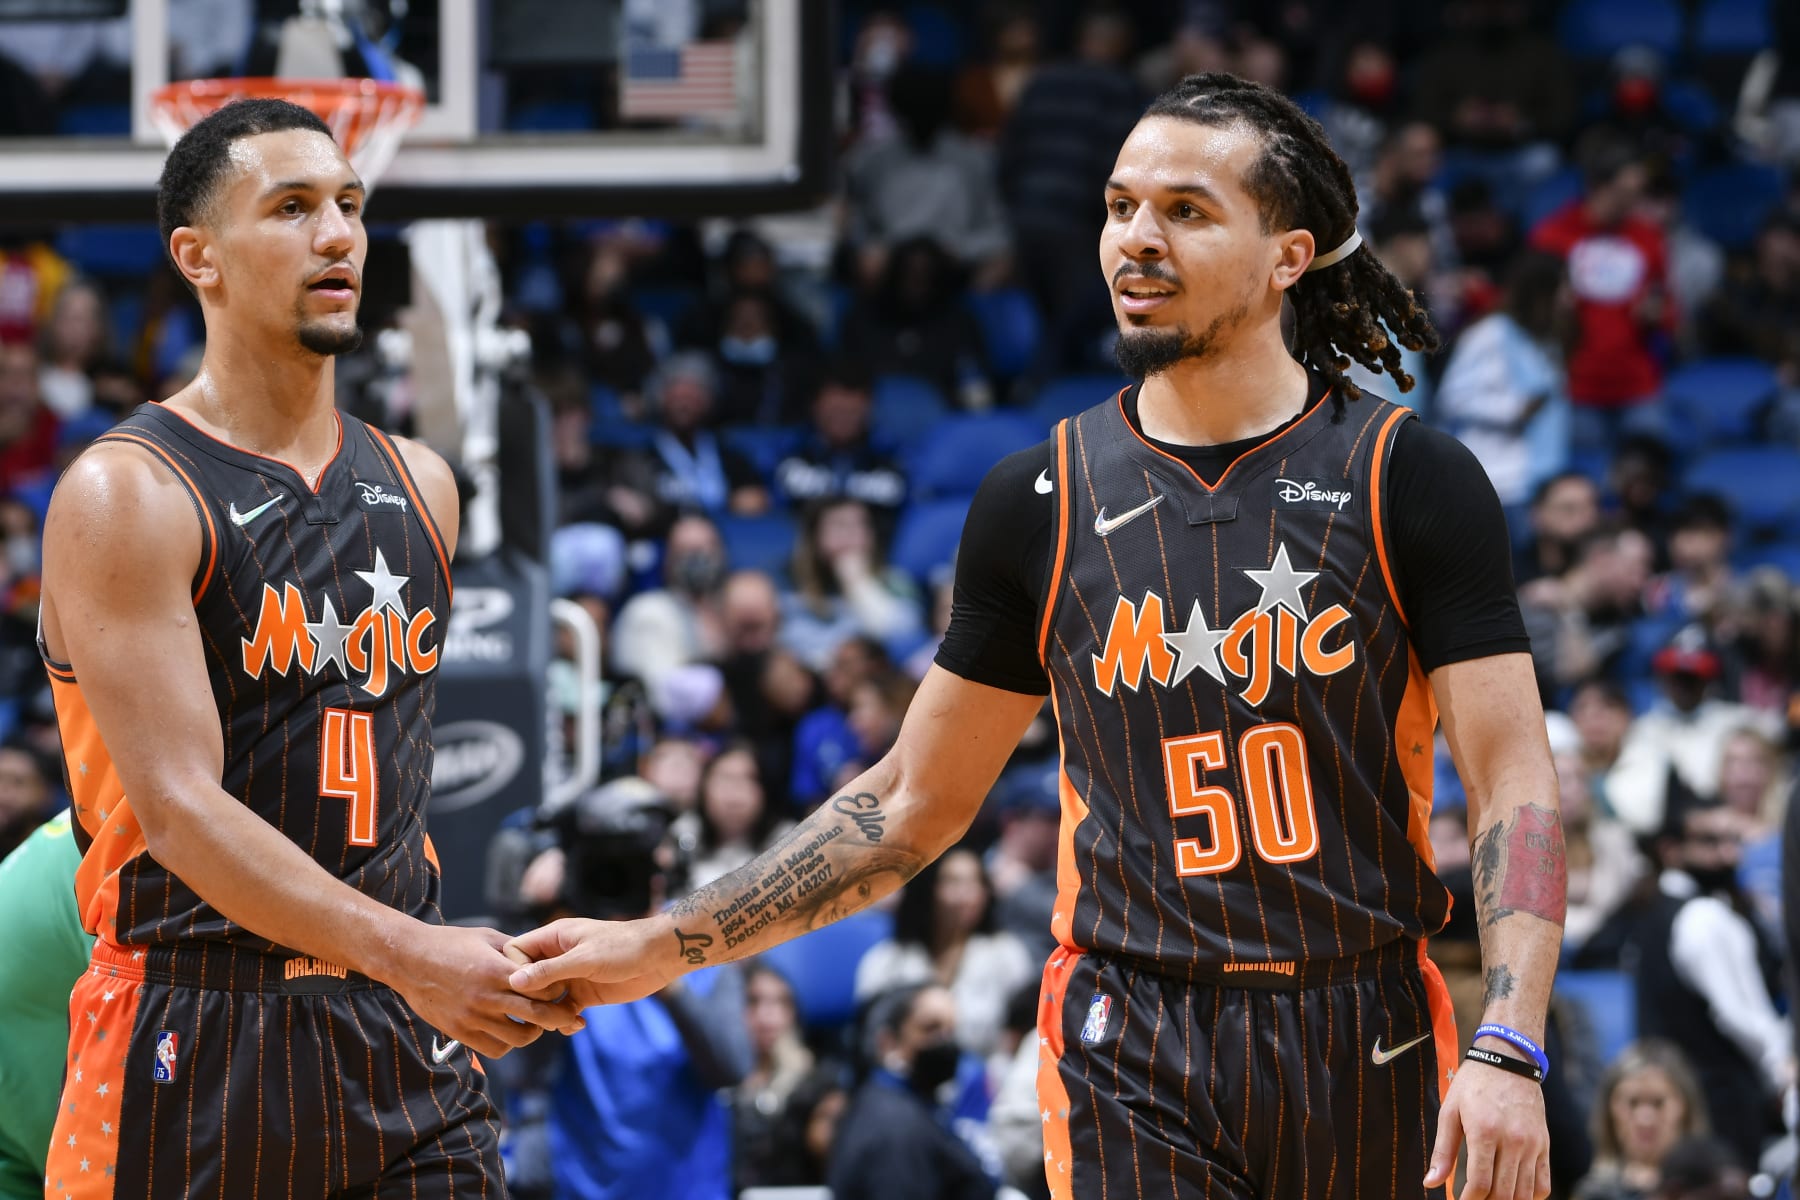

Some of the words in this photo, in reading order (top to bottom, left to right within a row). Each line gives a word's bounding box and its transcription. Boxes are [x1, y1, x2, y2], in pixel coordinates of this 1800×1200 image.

[355, 482, 407, 513] Disney
[1275, 479, 1352, 511] Disney
[320, 707, 377, 847] 4
[832, 792, 886, 842] Ella
[1160, 721, 1321, 877] 50
[713, 886, 761, 926] Thelma
[761, 864, 786, 889] and
[784, 825, 843, 871] Magellan
[722, 914, 746, 938] 1954
[744, 875, 795, 919] Thornhill
[793, 853, 825, 881] Place
[725, 910, 777, 951] Detroit,
[774, 892, 797, 915] MI
[797, 862, 833, 898] 48207
[674, 928, 714, 965] Leo
